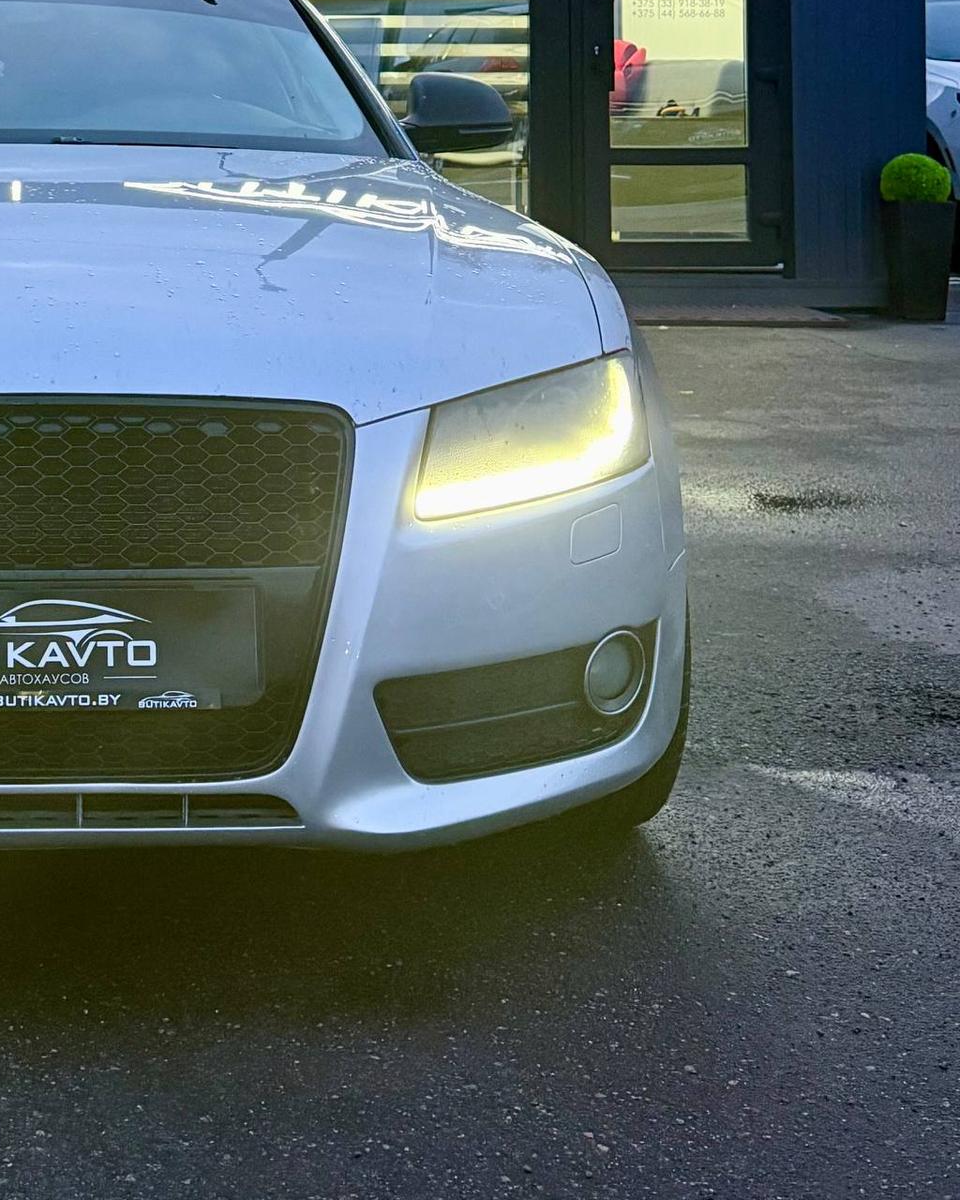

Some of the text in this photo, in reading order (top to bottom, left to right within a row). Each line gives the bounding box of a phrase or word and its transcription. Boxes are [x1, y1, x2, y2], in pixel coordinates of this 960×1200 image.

[632, 0, 655, 8] +375
[632, 9, 655, 18] +375
[0, 672, 90, 686] АВТОХАУСОВ
[137, 699, 197, 709] BUTIKAVTO
